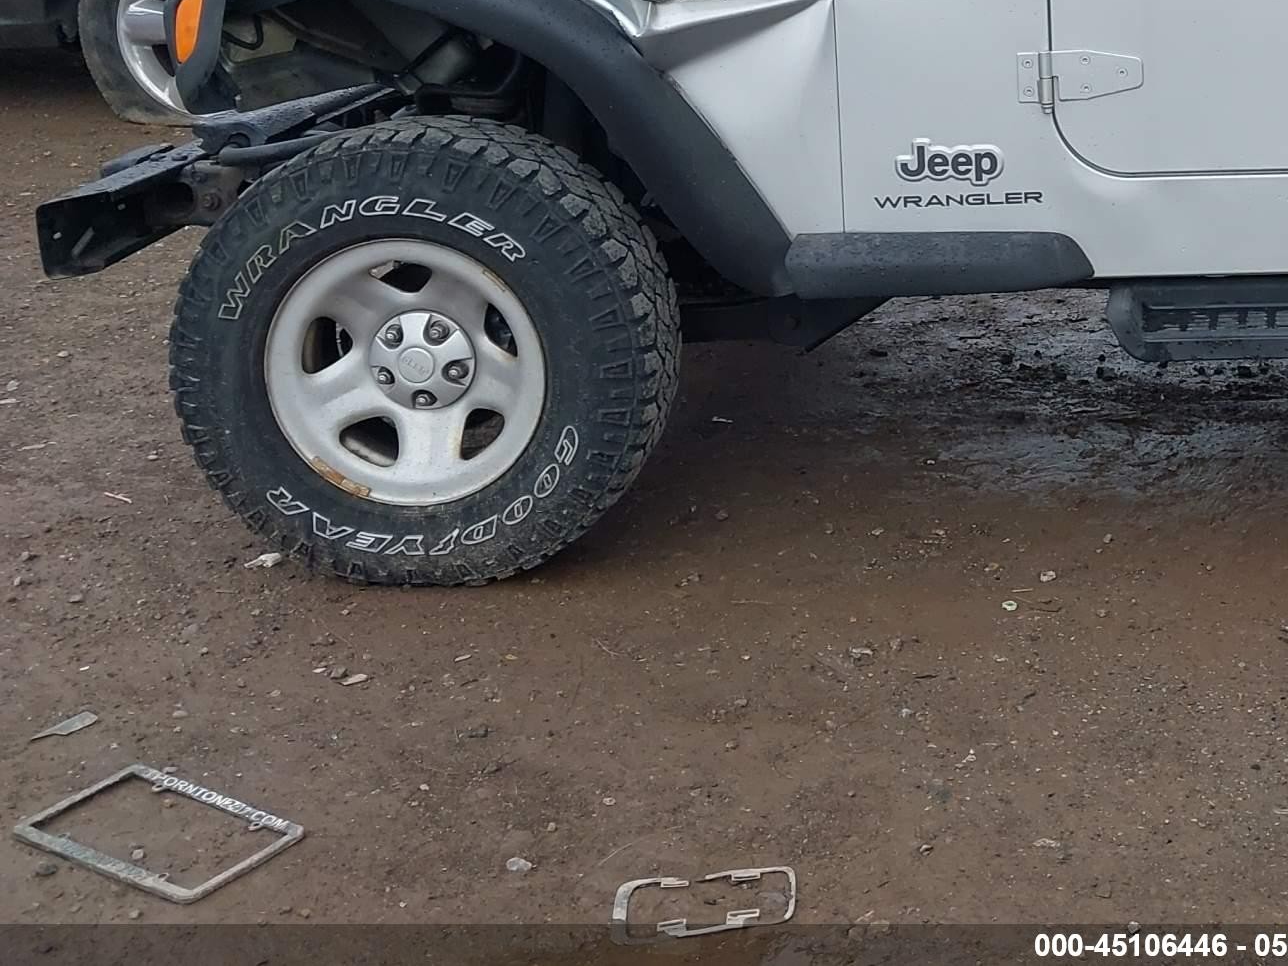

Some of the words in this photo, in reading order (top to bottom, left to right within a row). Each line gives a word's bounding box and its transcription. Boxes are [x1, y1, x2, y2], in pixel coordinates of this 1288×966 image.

[874, 191, 1044, 209] WRANGLER
[898, 143, 1000, 182] Jeep
[218, 195, 526, 321] WRANGLER
[266, 424, 580, 556] GOODYEAR
